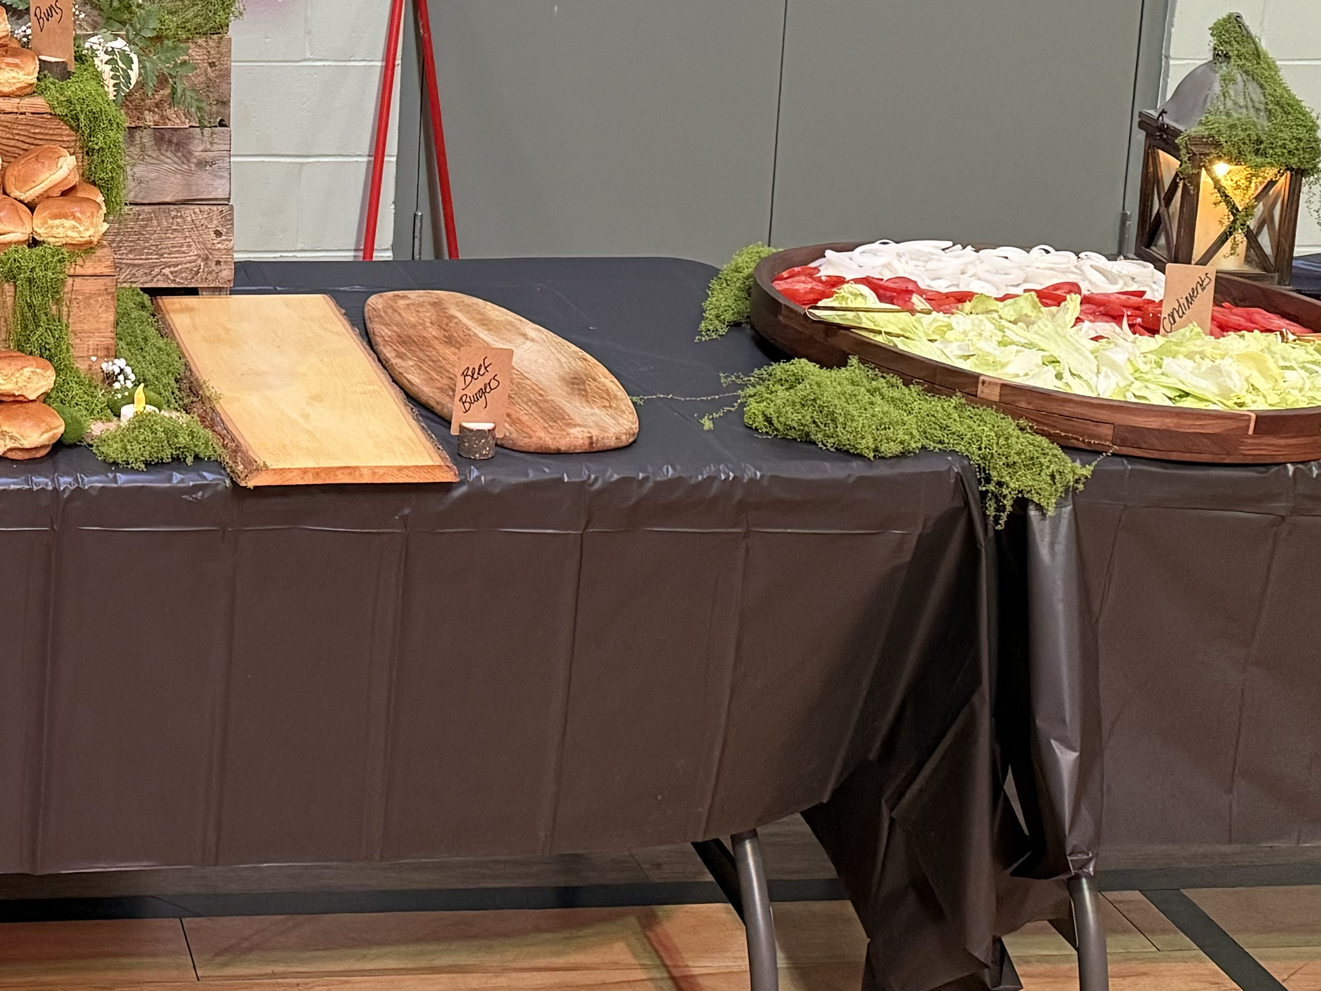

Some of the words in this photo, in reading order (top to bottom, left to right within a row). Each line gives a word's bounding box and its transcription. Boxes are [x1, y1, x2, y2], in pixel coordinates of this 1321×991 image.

[34, 0, 64, 33] Buns
[460, 356, 493, 391] Beef
[458, 373, 501, 414] Burgers
